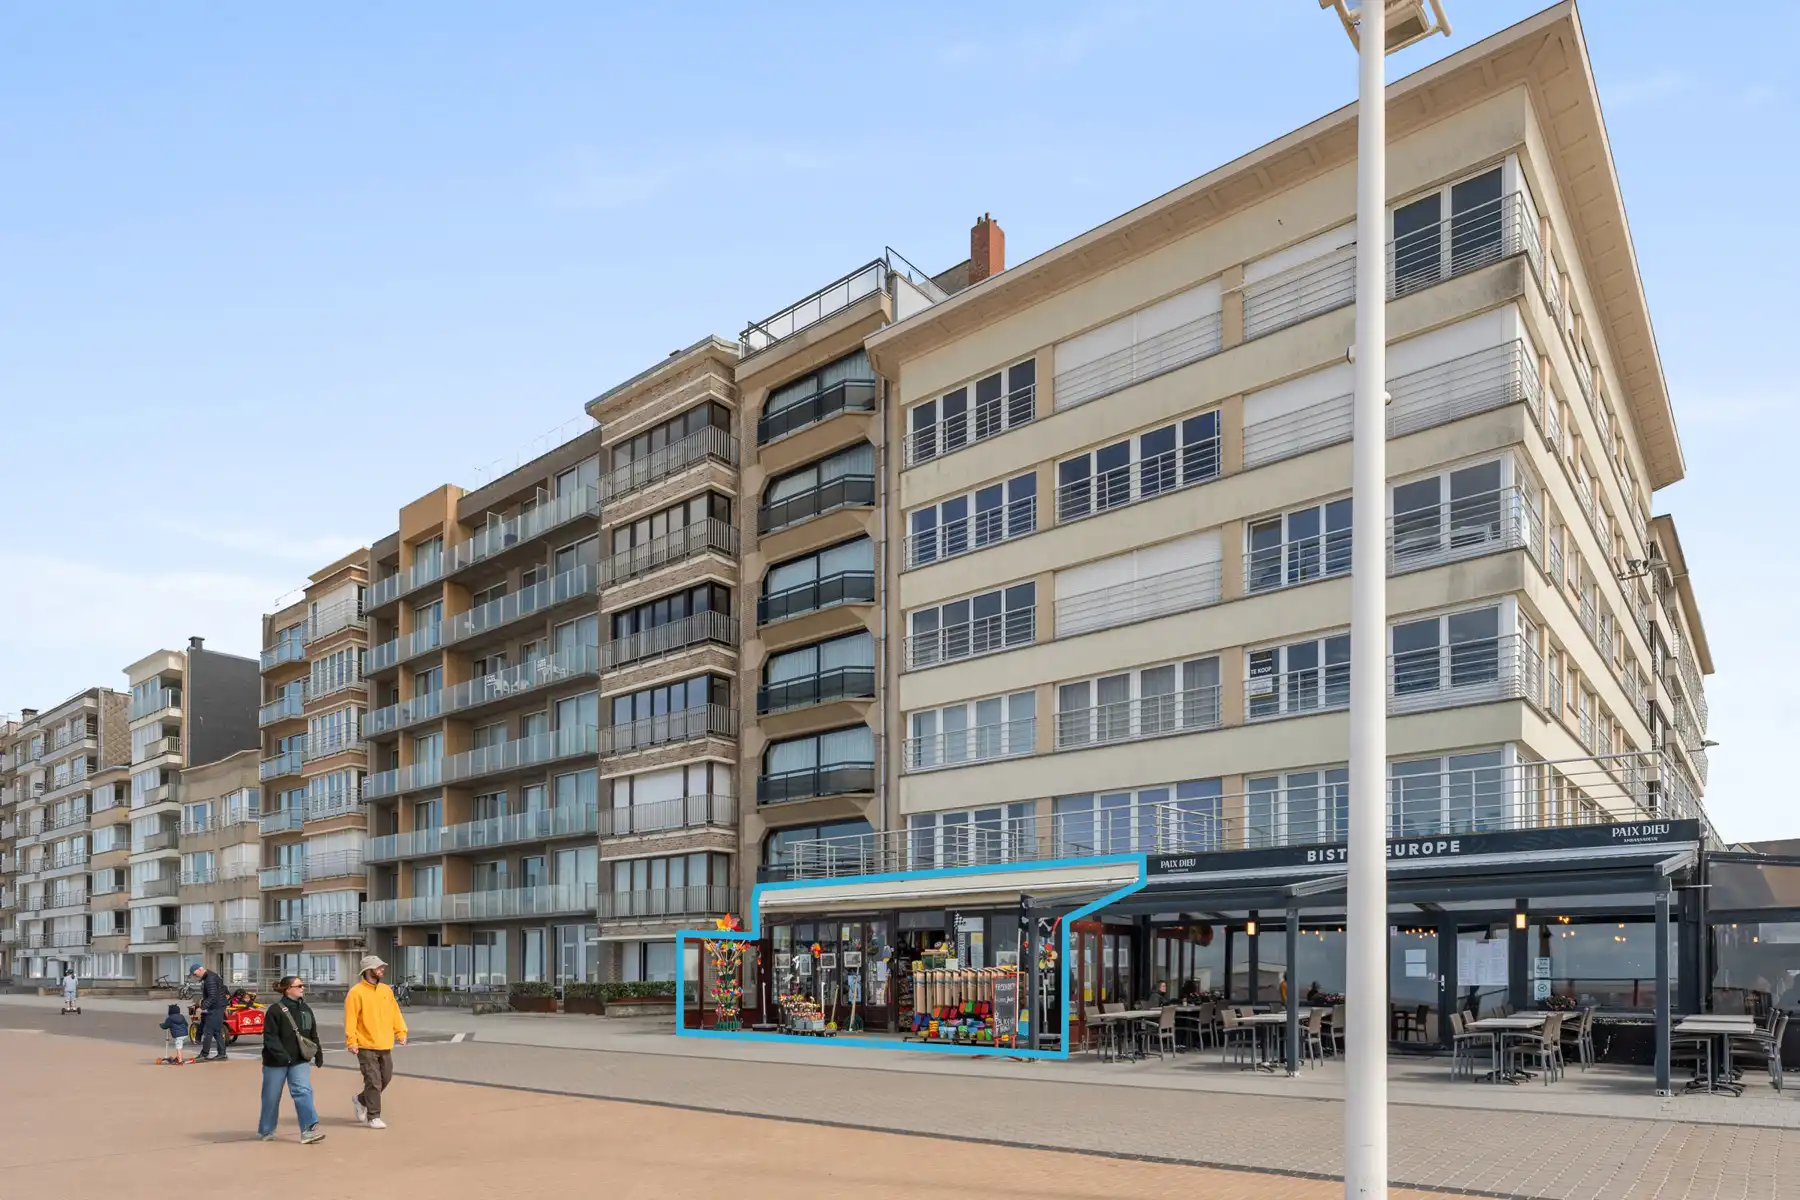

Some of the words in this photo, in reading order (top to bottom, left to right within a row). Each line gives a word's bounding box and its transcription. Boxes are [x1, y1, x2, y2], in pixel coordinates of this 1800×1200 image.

[1257, 666, 1272, 674] KOOP
[1612, 826, 1639, 837] PAIX
[1642, 824, 1670, 835] DIEU
[1307, 849, 1348, 862] BIST
[1160, 860, 1178, 868] PAIX
[1179, 858, 1196, 867] DIEU
